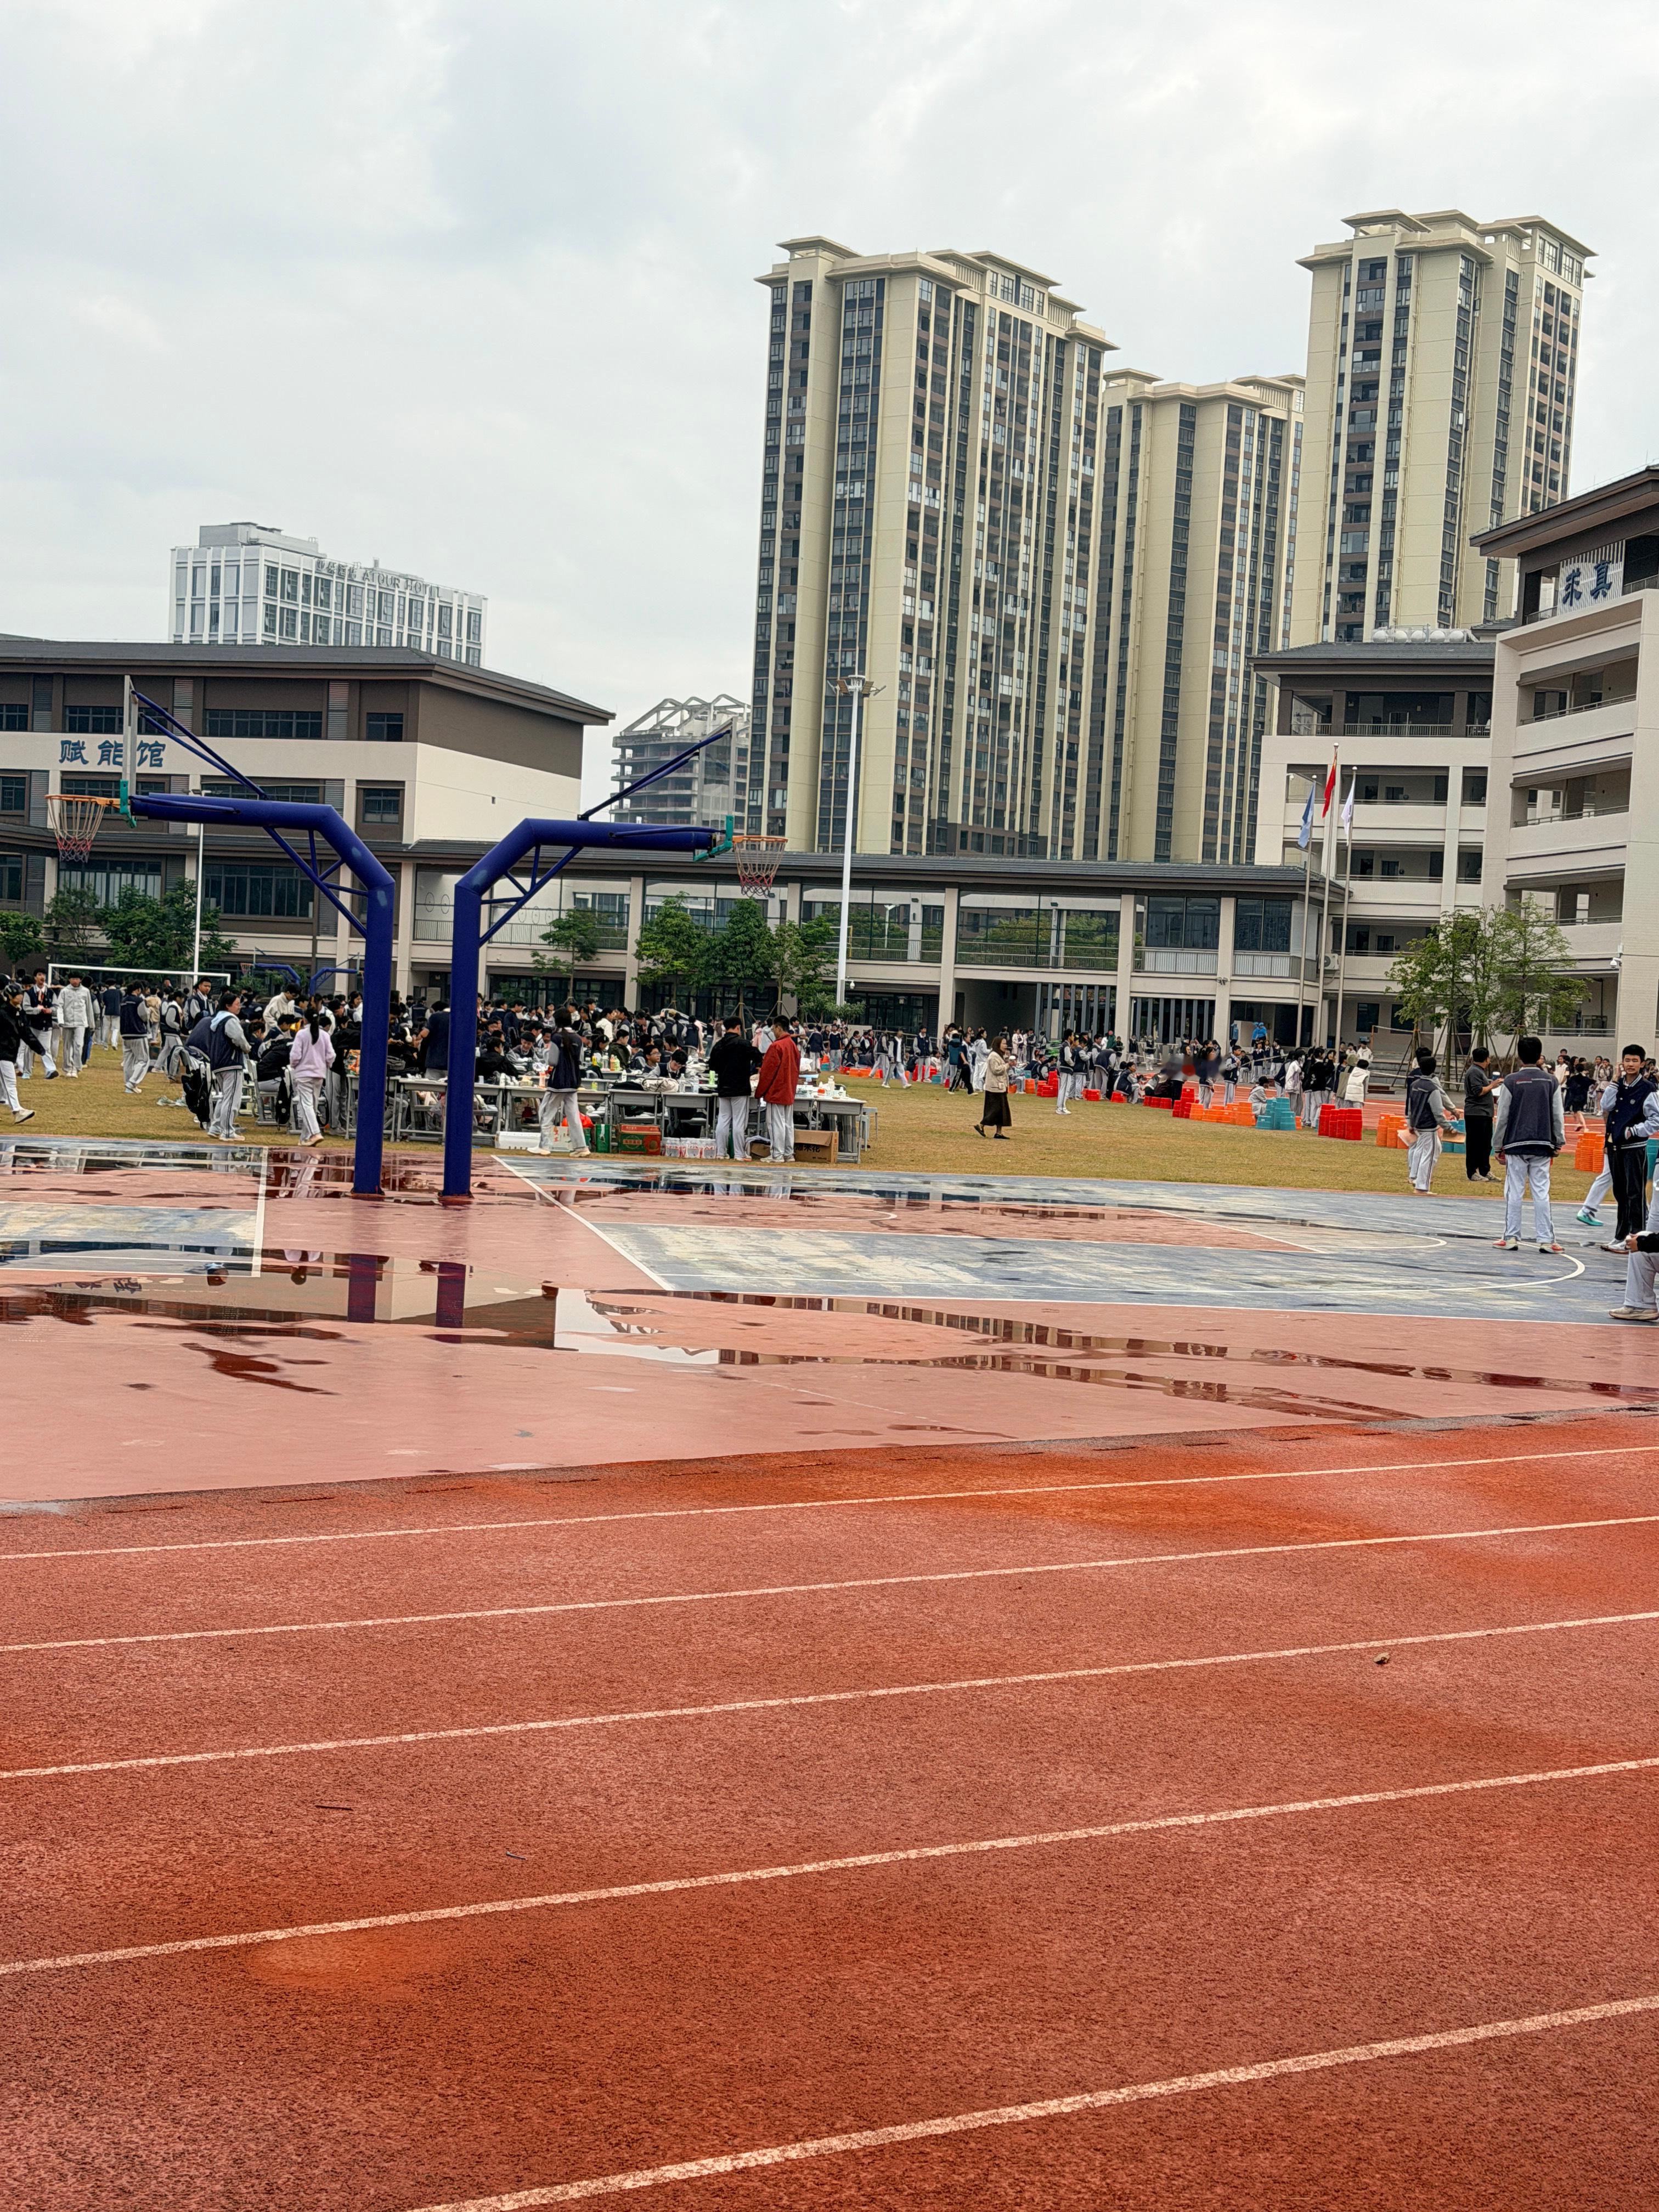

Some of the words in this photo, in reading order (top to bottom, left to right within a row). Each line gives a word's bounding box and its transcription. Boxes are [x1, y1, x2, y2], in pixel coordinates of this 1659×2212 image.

[363, 569, 400, 589] ATOUR
[405, 579, 441, 598] HOTEL
[1562, 560, 1613, 607] 求真
[59, 740, 166, 768] 赋能馆
